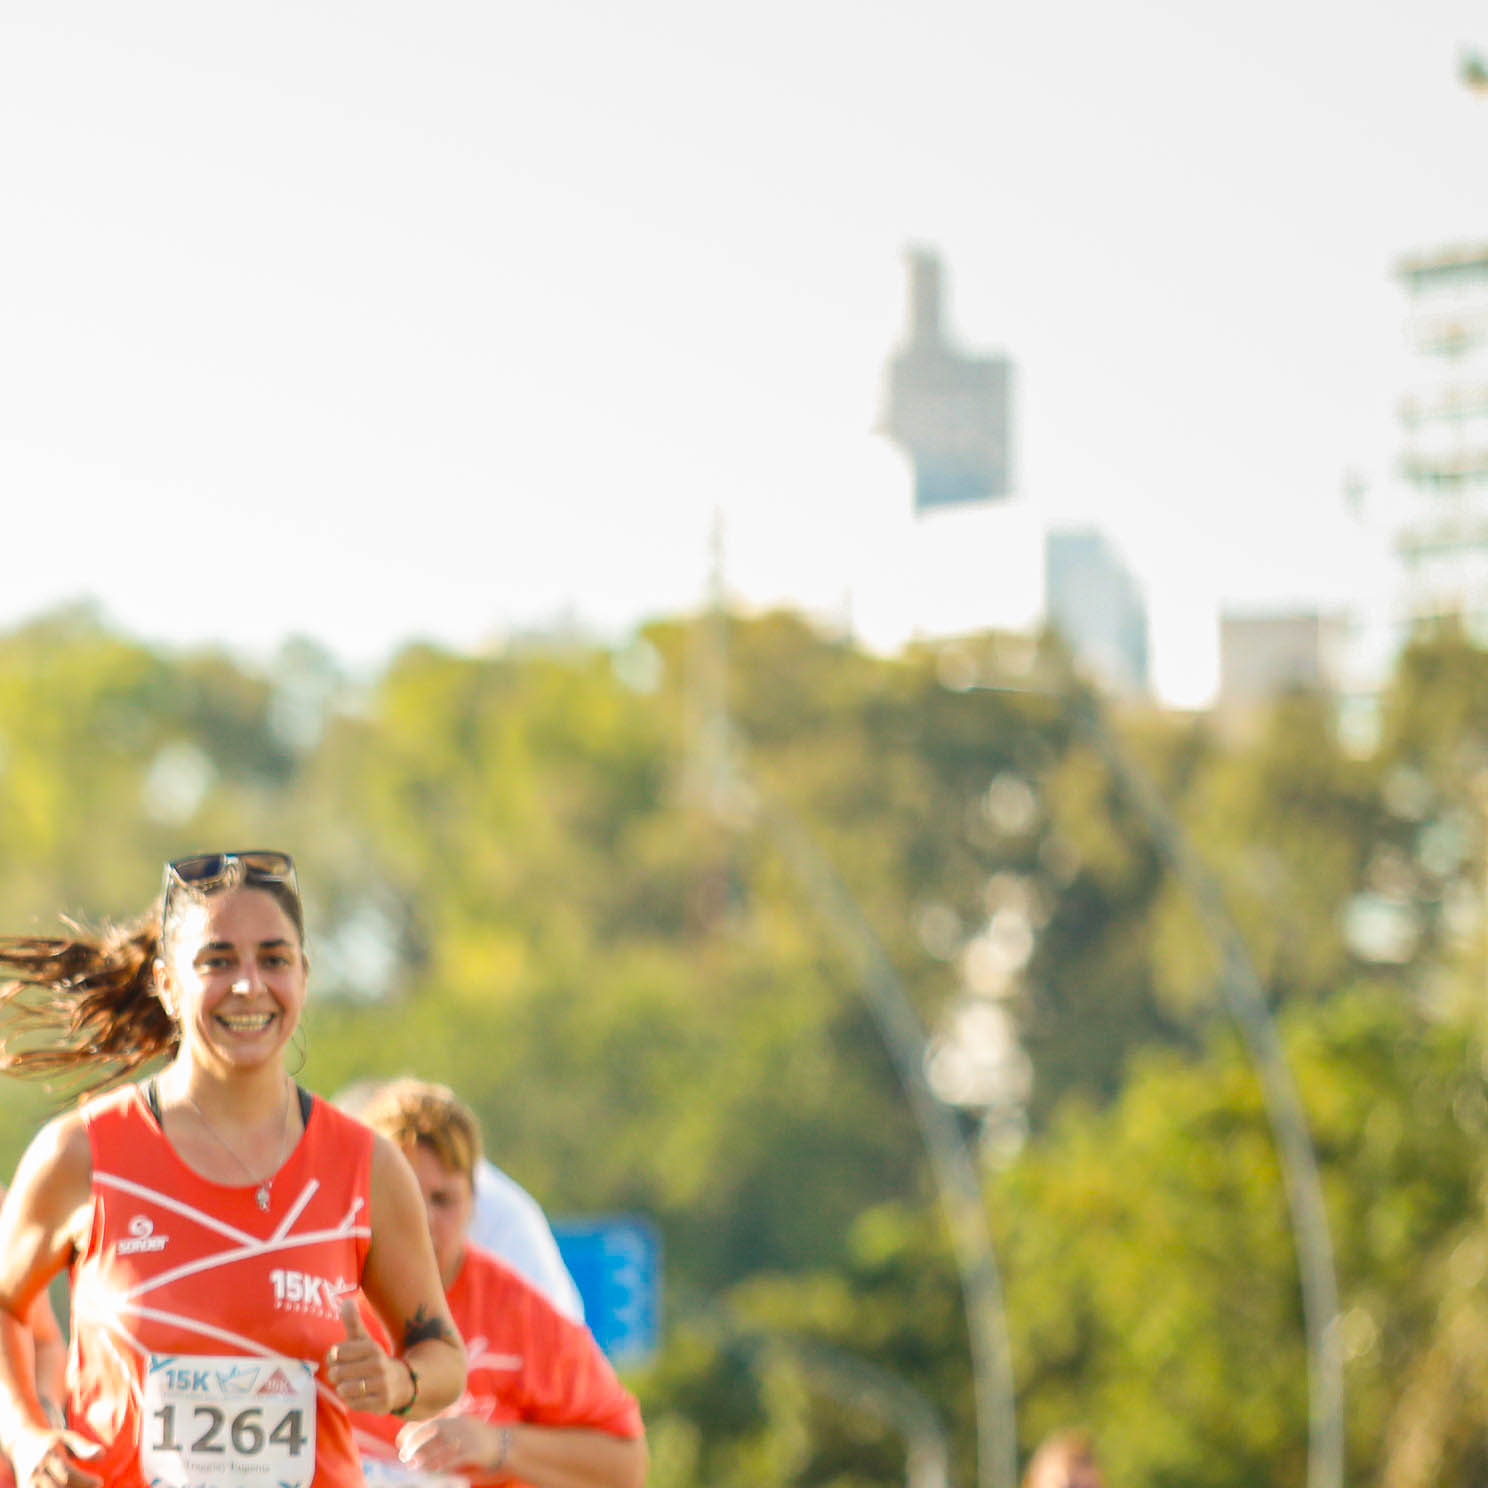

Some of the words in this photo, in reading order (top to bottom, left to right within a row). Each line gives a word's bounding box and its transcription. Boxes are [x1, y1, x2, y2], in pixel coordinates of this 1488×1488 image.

[270, 1269, 323, 1307] 15K
[166, 1369, 209, 1392] 15K
[151, 1404, 308, 1457] 1264
